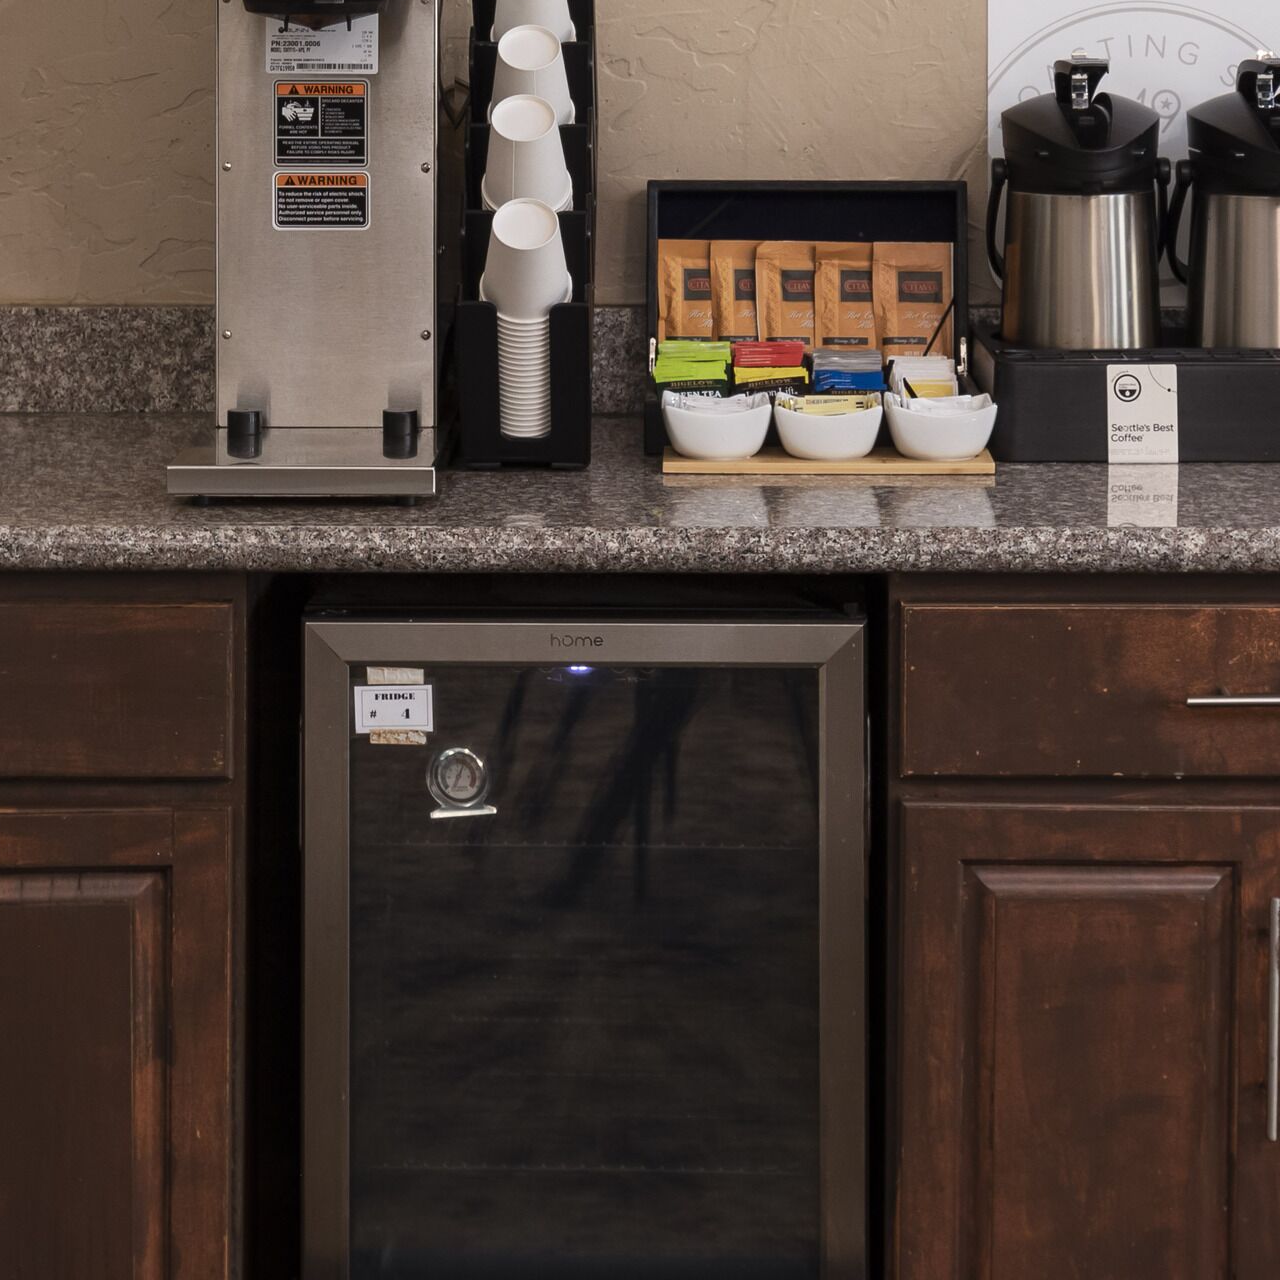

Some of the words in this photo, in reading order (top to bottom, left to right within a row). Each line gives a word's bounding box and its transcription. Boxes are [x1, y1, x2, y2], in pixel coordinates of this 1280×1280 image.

[304, 86, 353, 94] WARNING
[298, 176, 357, 185] WARNING
[1111, 423, 1150, 432] Seattle's
[1153, 424, 1174, 432] Best
[1111, 434, 1142, 442] Coffee
[550, 633, 604, 647] home
[375, 692, 415, 700] FRIDGE
[370, 710, 377, 718] #
[401, 708, 410, 719] 4
